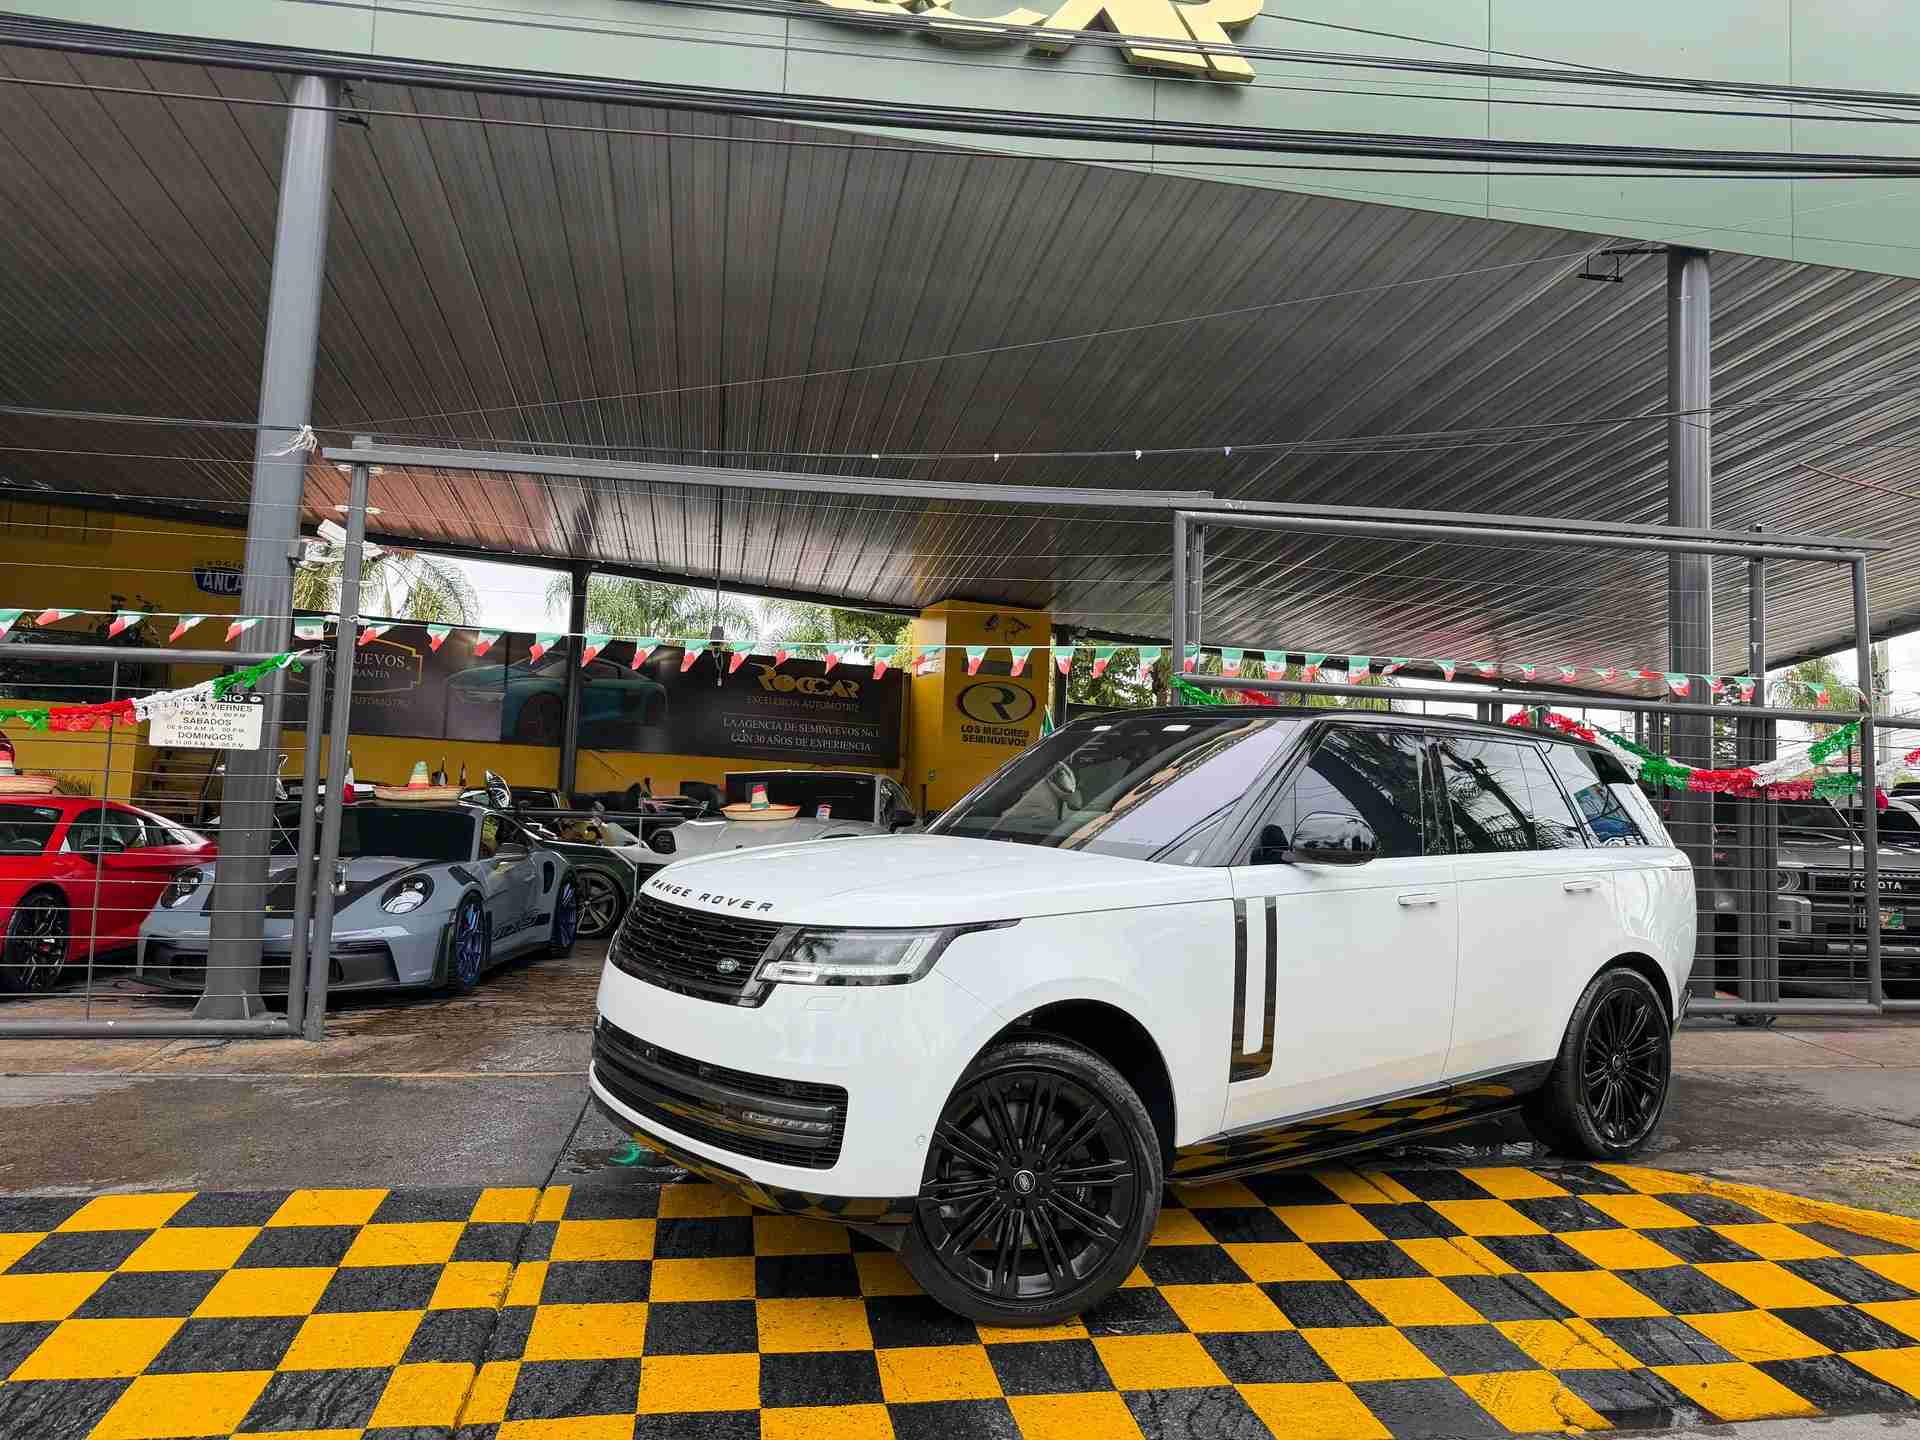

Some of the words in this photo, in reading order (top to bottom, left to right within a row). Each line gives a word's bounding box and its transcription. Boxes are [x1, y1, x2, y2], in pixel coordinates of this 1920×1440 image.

[750, 663, 860, 699] ROCCAR
[210, 703, 253, 712] VIERNES
[178, 731, 234, 741] DOMINGOS
[737, 718, 782, 730] AGENCIA
[784, 720, 796, 732] DE
[799, 722, 860, 738] SEMINUEVOS
[961, 724, 980, 734] LOS
[983, 726, 1030, 738] MEJORES
[731, 730, 752, 743] CON
[766, 733, 793, 746] AÑOS
[795, 736, 808, 747] DE
[809, 737, 872, 752] EXPERIENCIA
[962, 734, 1027, 747] SEMINUEVOS
[651, 879, 693, 898] RANGE
[698, 893, 774, 912] ROVER
